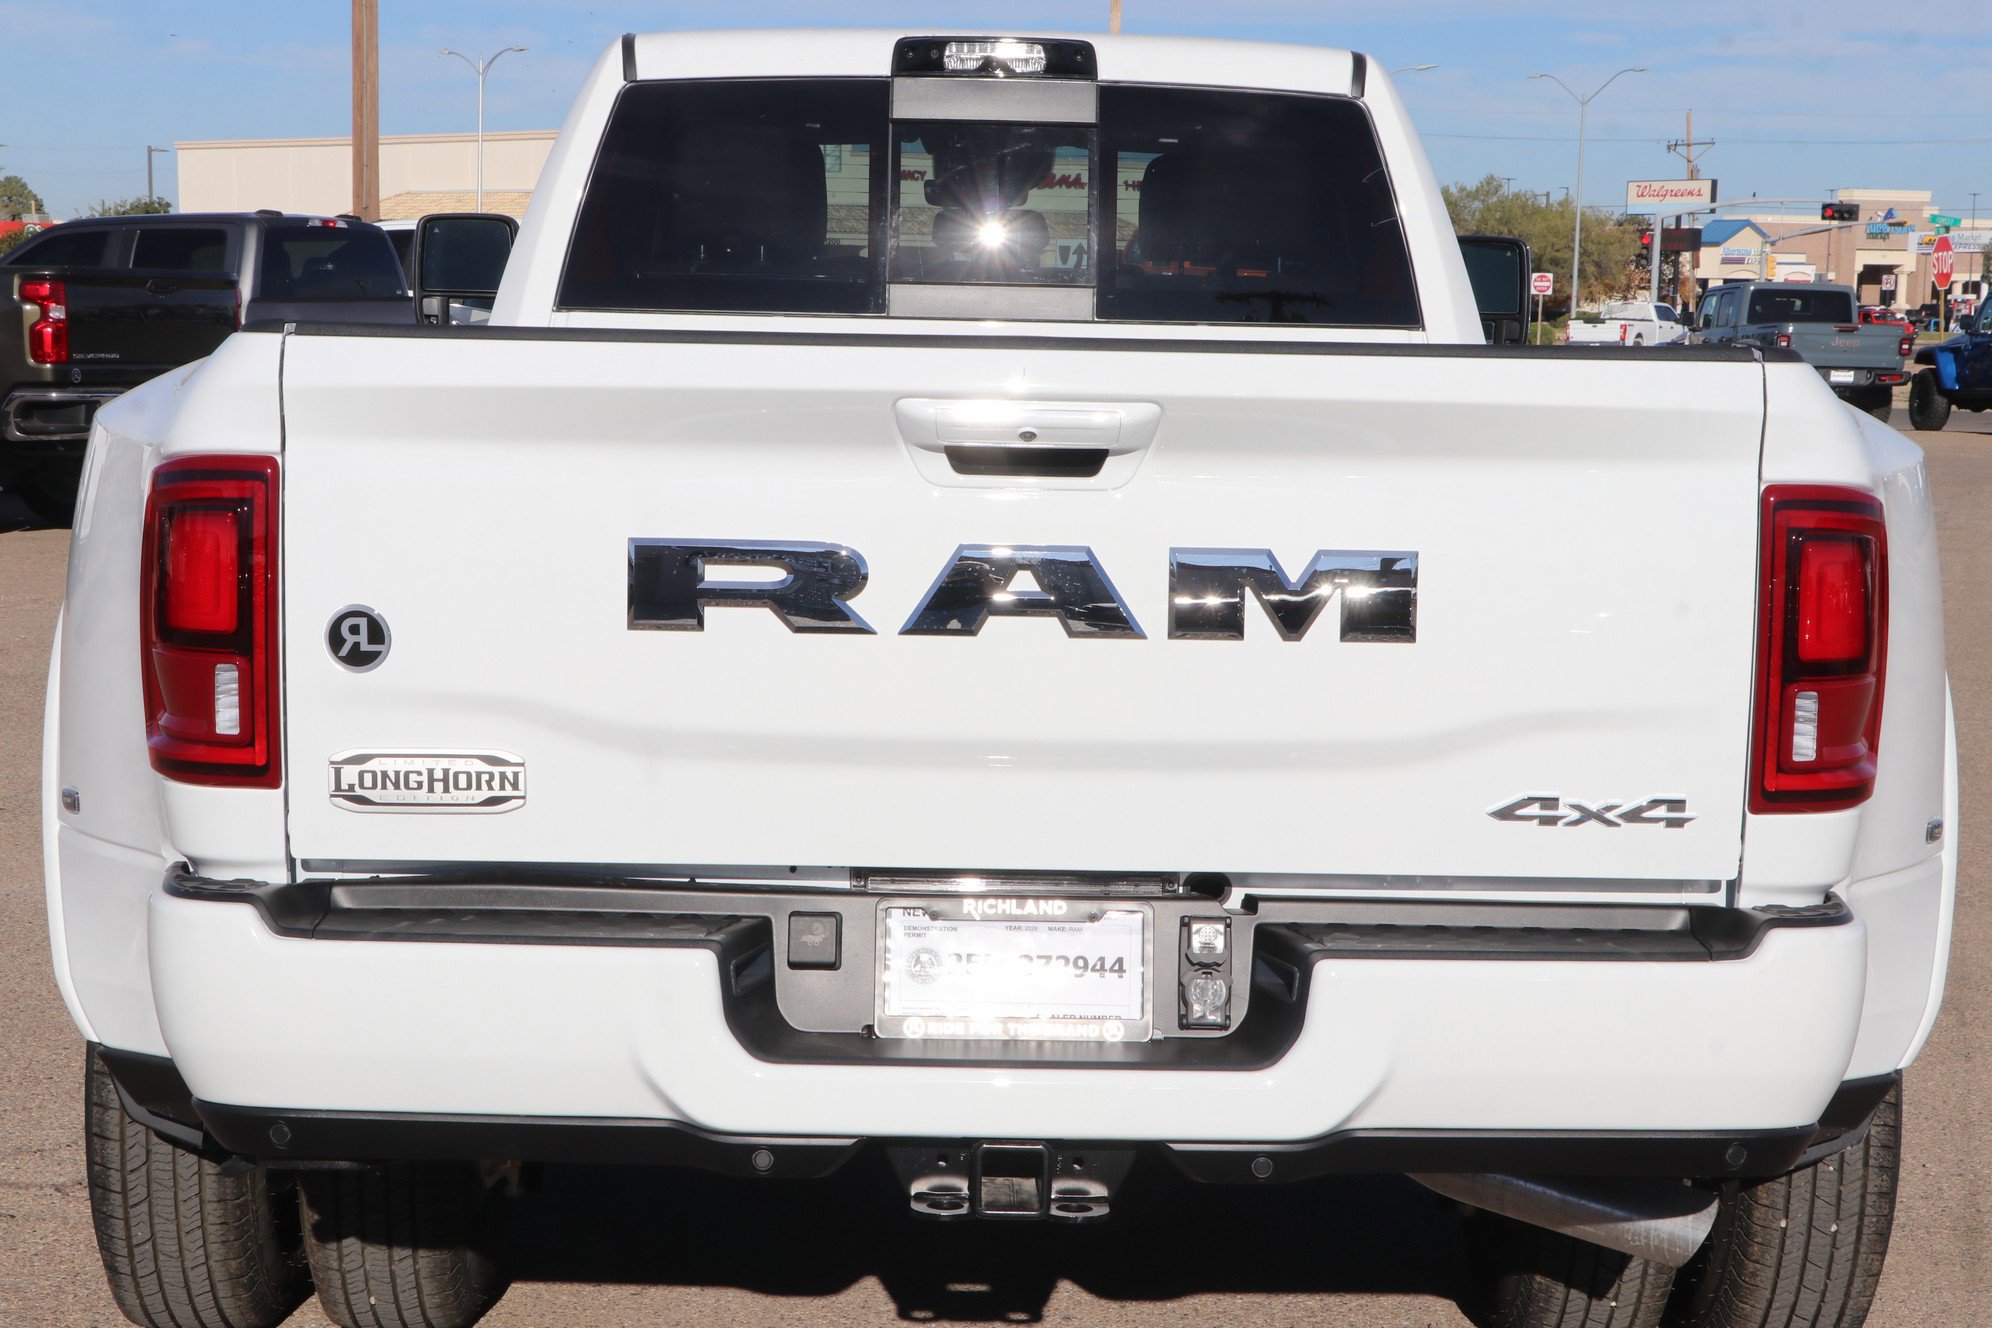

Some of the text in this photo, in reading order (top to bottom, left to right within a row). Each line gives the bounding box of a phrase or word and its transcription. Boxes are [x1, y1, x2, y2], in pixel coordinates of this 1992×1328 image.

[1635, 184, 1704, 203] Walgreens
[1932, 251, 1954, 275] STOP
[1831, 336, 1860, 350] Jeep
[627, 536, 1420, 644] RAM
[378, 759, 475, 767] LIMITED
[379, 793, 476, 802] EDITION
[1486, 791, 1699, 829] 4x4
[962, 898, 1068, 920] RICHLAND
